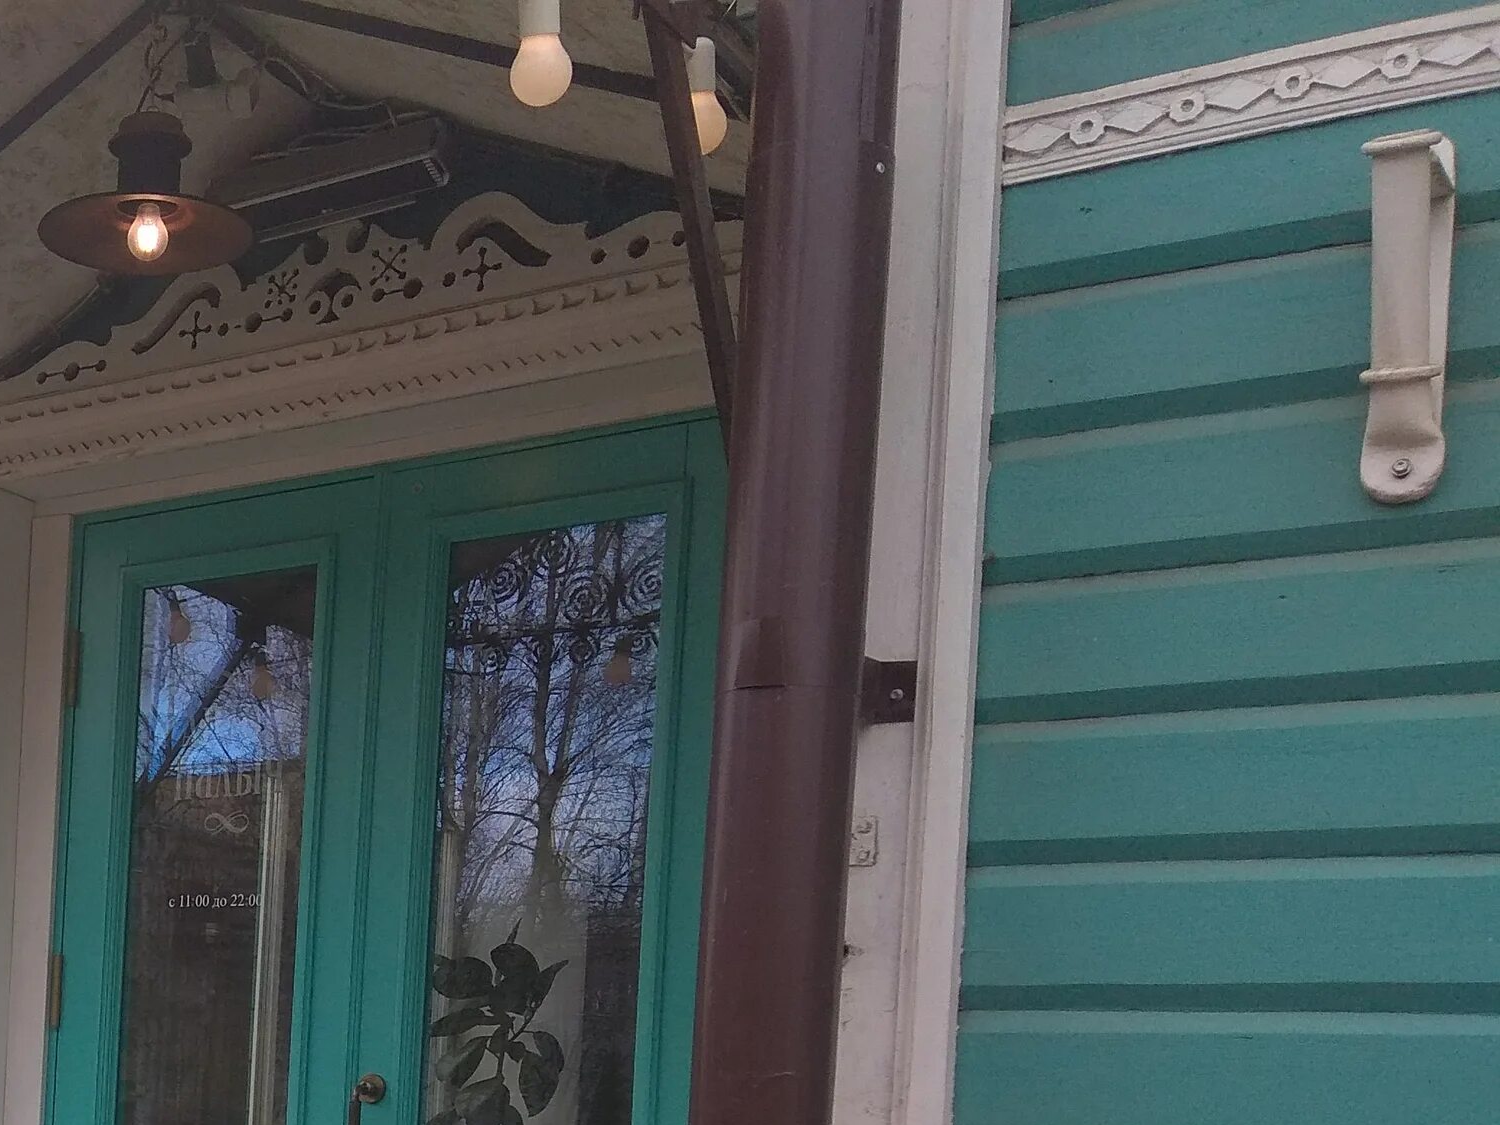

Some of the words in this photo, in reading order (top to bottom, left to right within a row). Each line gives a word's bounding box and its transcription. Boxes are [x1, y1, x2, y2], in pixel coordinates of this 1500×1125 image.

[168, 898, 175, 908] с
[180, 894, 210, 908] 11:00
[211, 897, 227, 909] до
